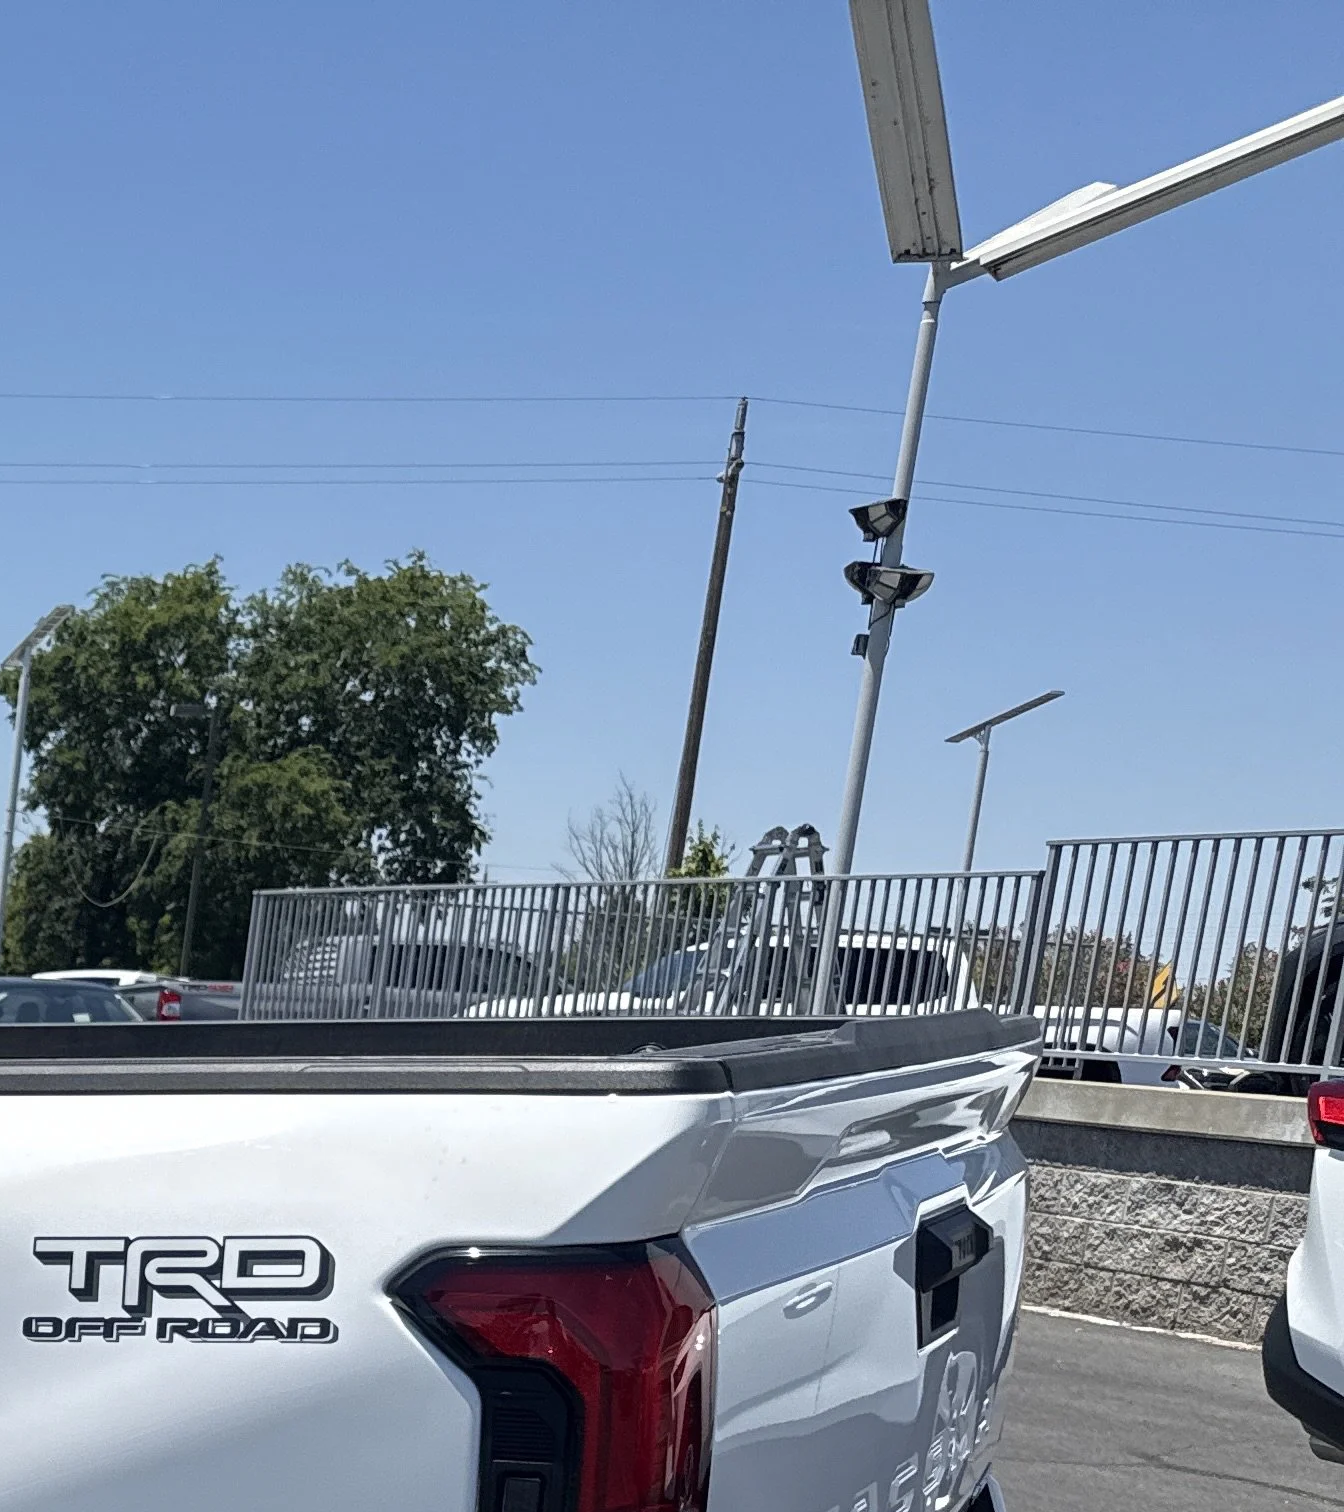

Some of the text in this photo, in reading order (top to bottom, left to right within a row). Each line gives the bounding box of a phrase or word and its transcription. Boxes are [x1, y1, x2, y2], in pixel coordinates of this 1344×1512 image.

[32, 1235, 336, 1320] TRD
[22, 1316, 339, 1344] OFF ROAD
